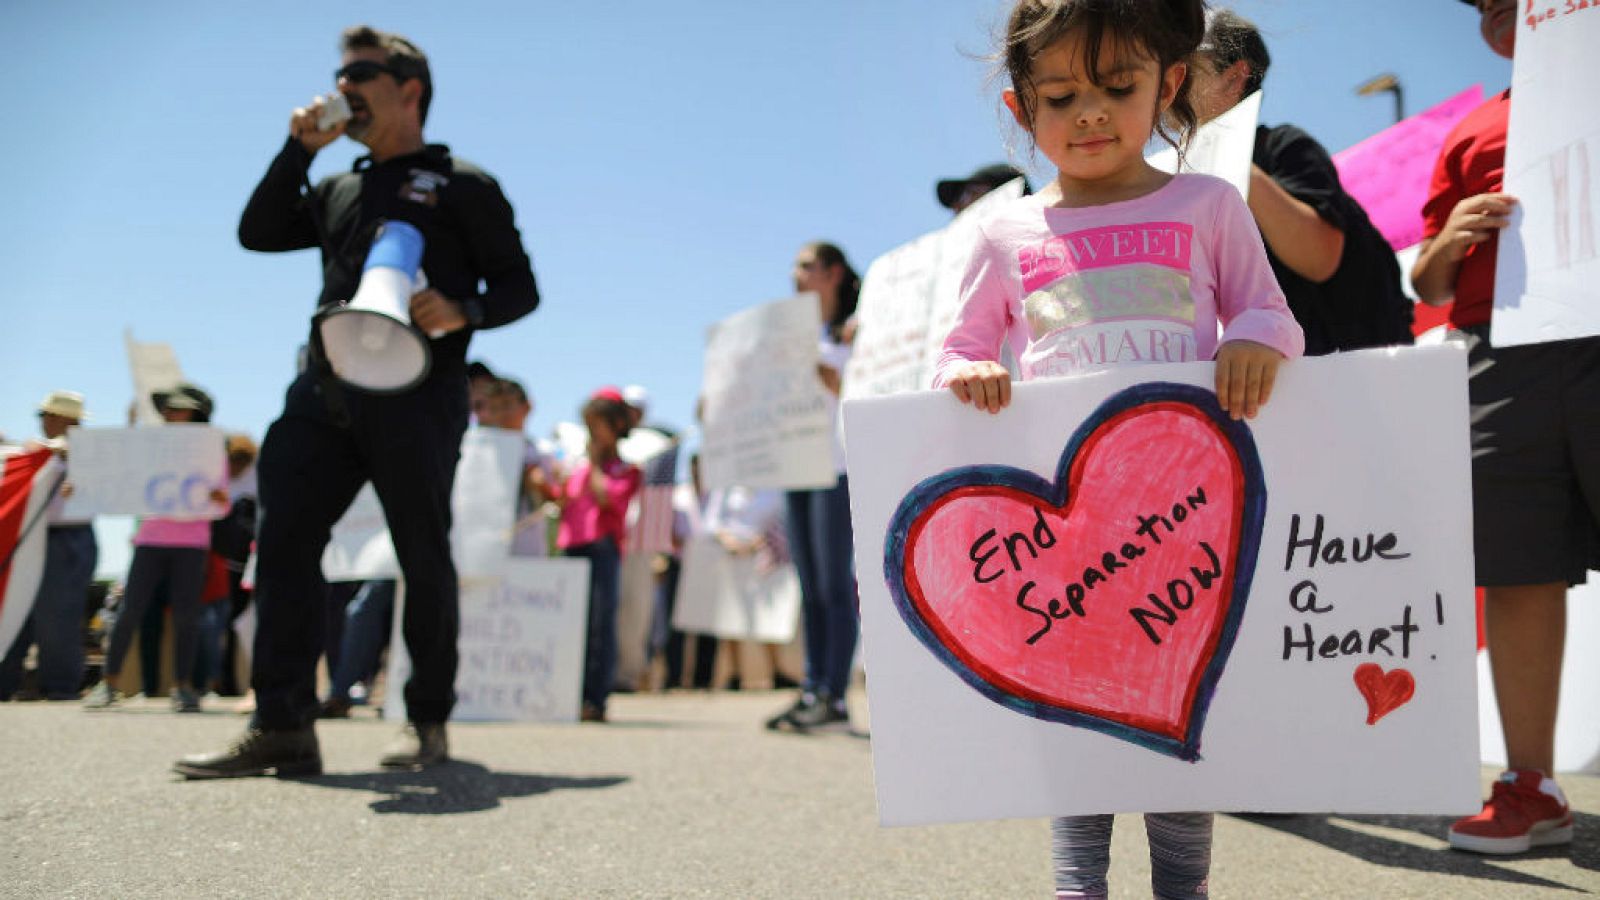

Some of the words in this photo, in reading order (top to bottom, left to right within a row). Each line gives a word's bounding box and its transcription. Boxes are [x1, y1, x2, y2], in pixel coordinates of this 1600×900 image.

[970, 506, 1057, 584] End
[1284, 513, 1411, 571] Have
[1129, 541, 1222, 645] NOW
[1288, 579, 1334, 613] a
